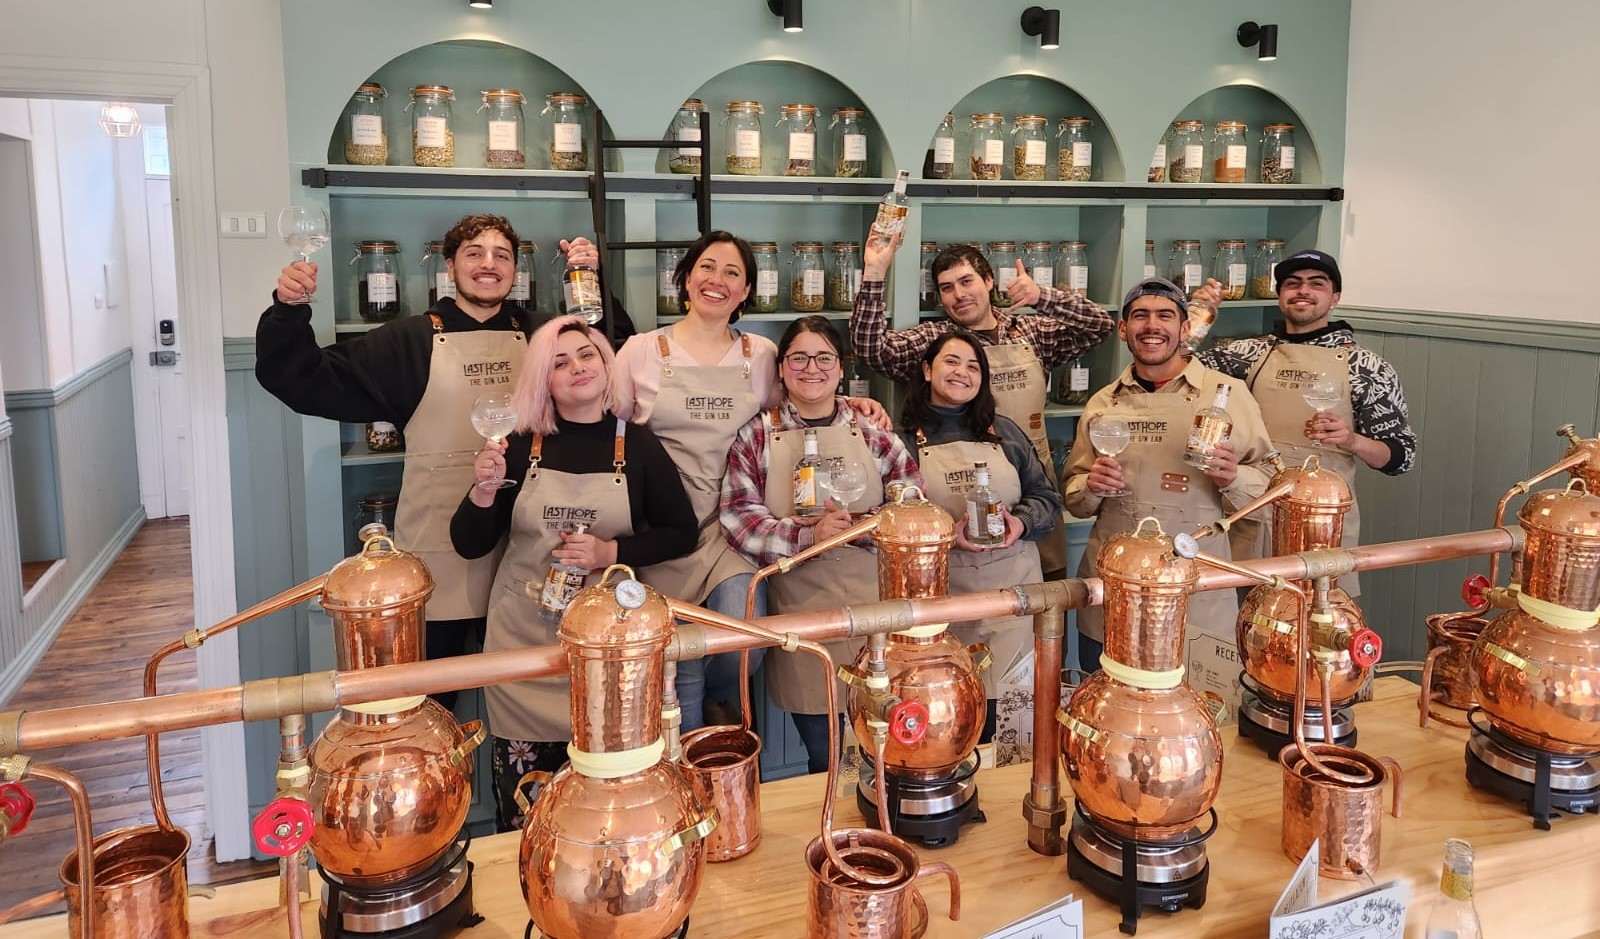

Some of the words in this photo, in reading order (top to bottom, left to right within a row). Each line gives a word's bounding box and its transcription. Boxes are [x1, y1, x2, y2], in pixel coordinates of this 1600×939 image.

[463, 363, 484, 376] LAST
[485, 361, 512, 376] HOPE
[1276, 370, 1293, 380] LAST
[484, 377, 495, 385] GIN
[497, 376, 510, 384] LAB
[1007, 369, 1028, 382] HOPE
[686, 397, 706, 410] LAST
[707, 397, 734, 411] HOPE
[690, 412, 702, 420] THE
[705, 412, 715, 420] GIN
[718, 412, 730, 420] LAB
[1141, 421, 1168, 434] HOPE
[945, 471, 965, 484] LAST
[543, 505, 567, 519] LAST
[567, 507, 598, 521] HOPE
[546, 521, 559, 530] THE
